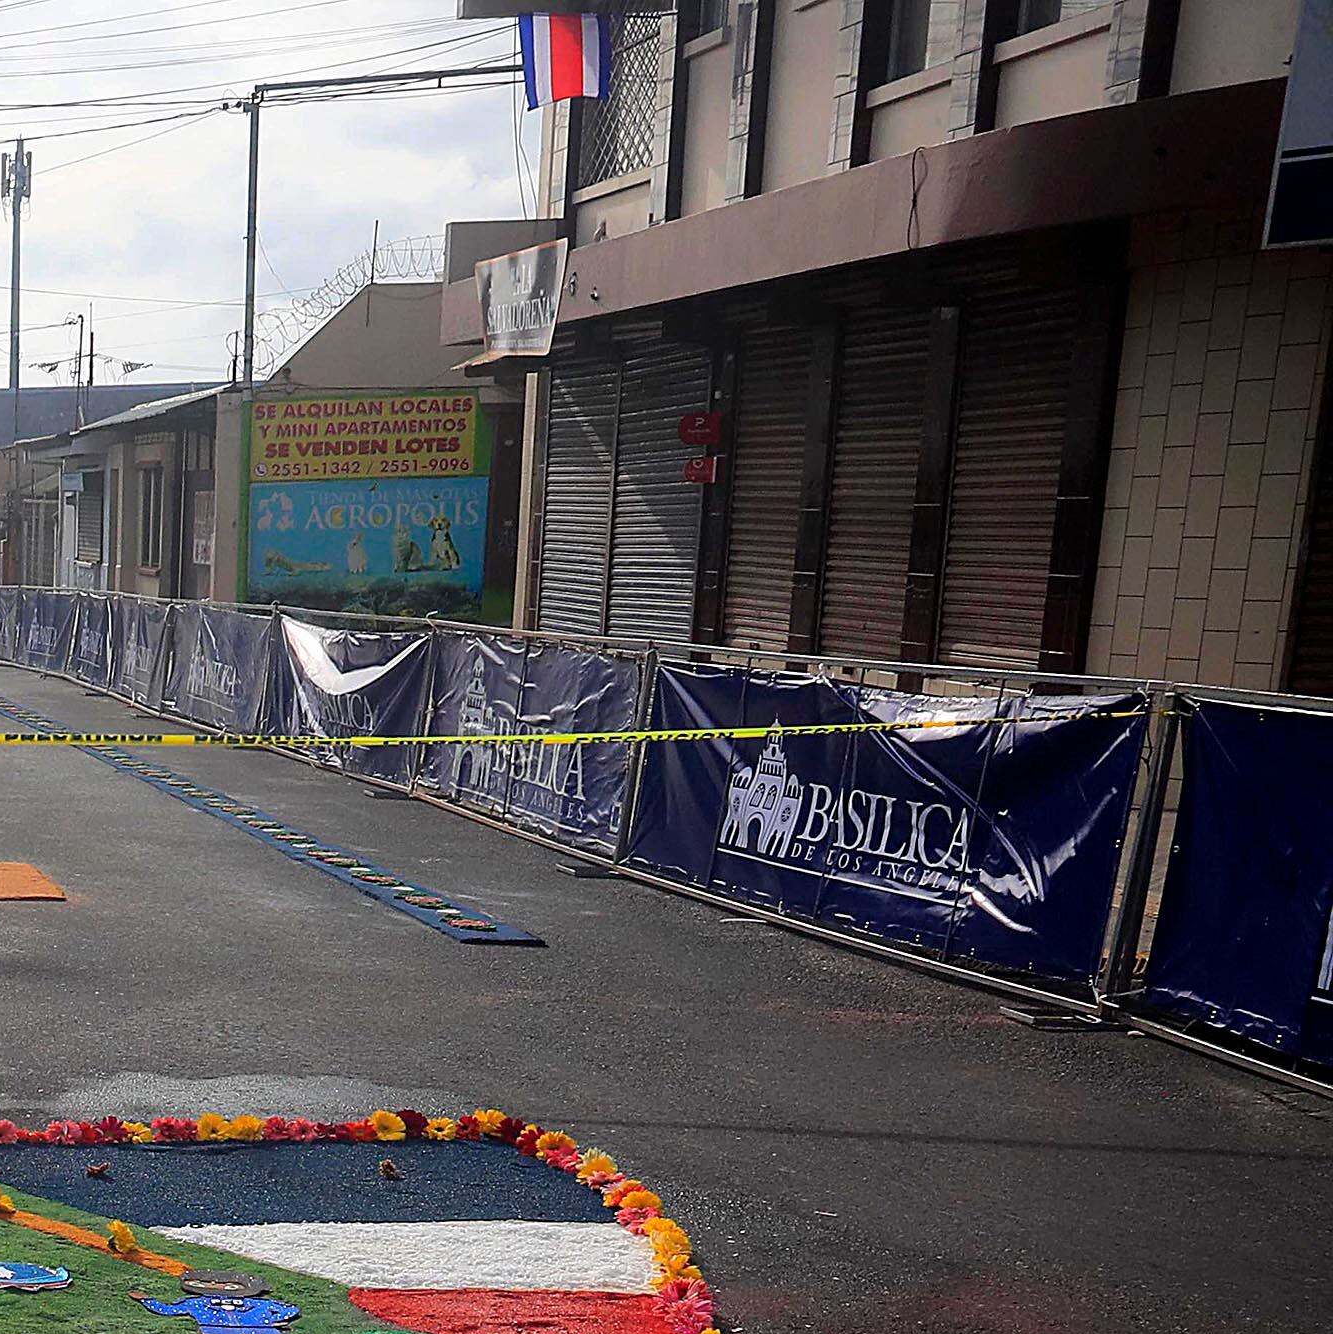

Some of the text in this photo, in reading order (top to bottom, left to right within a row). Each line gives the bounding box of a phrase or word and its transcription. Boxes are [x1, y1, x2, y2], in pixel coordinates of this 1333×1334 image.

[255, 396, 474, 421] SE ALQUILAN LOCALES
[259, 417, 468, 440] Y MINI APARTAMENTOS
[264, 436, 461, 459] SE VENDEN LOTES
[271, 460, 361, 477] 2551-1342
[379, 458, 470, 473] 2551-9096
[796, 782, 973, 874] BASILICA
[790, 842, 973, 894] DE LOS ANGELES
